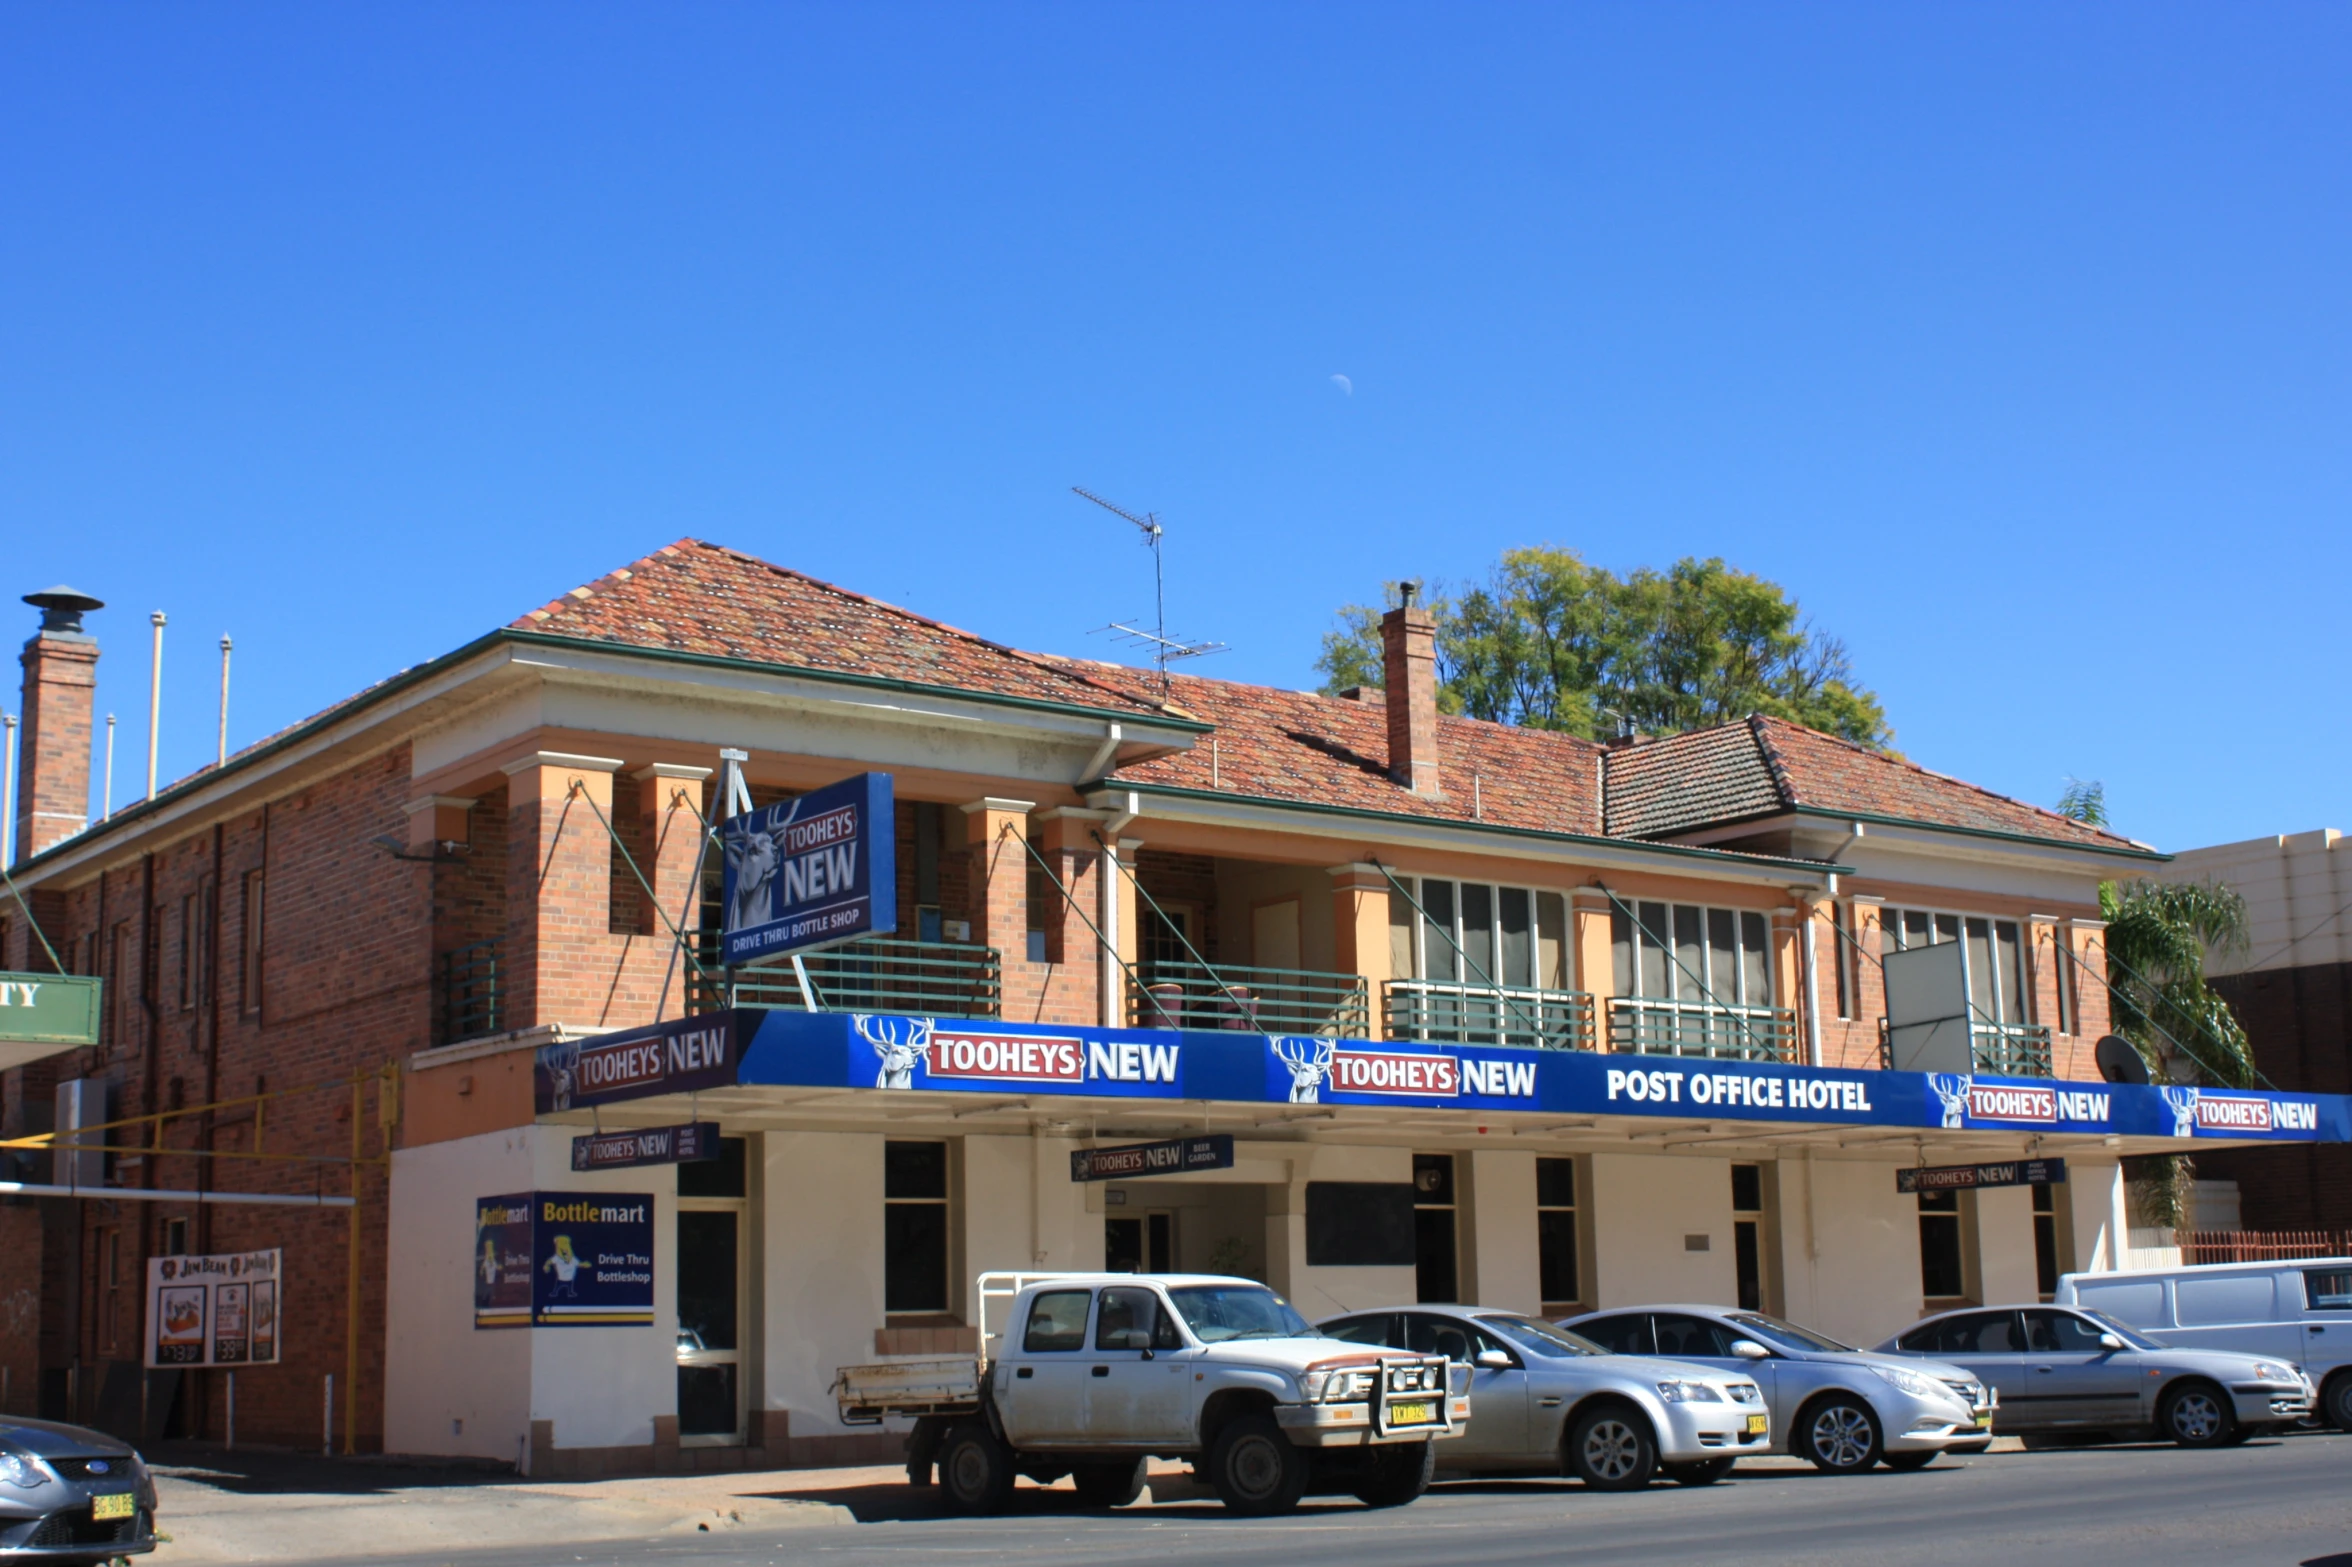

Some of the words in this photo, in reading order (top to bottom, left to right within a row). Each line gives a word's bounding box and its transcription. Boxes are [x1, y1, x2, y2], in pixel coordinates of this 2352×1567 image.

[788, 811, 853, 850] TOOHEYS
[784, 841, 857, 906] NEW
[733, 934, 761, 952] DRIVE
[763, 925, 789, 944] THRU
[792, 915, 829, 938] BOTTLE
[831, 908, 859, 929] SHOP
[581, 1044, 660, 1086] TOOHEYS
[668, 1026, 726, 1074] NEW
[935, 1039, 1076, 1075] TOOHEYS
[1088, 1042, 1179, 1083] NEW
[1336, 1057, 1452, 1090] TOOHEYS
[1461, 1060, 1537, 1096] NEW
[1607, 1069, 1683, 1102] POST
[1690, 1073, 1783, 1107] OFFICE
[1788, 1078, 1872, 1111] HOTEL
[1971, 1090, 2051, 1117] TOOHEYS
[2058, 1091, 2110, 1121] NEW
[2200, 1102, 2266, 1125] TOOHEYS
[2272, 1101, 2317, 1130] NEW
[592, 1140, 634, 1160] TOOHEYS
[638, 1133, 669, 1158] NEW
[1093, 1152, 1142, 1171] TOOHEYS
[1146, 1145, 1180, 1168] NEW
[1188, 1152, 1216, 1163] GARDEN
[1193, 1143, 1210, 1152] BEER
[1922, 1169, 1974, 1185] TOOHEYS
[1977, 1166, 2014, 1183] NEW
[543, 1202, 645, 1223] Bottlemart
[598, 1254, 624, 1265] Drive
[627, 1254, 649, 1265] Thru
[597, 1272, 650, 1284] Bottleshop
